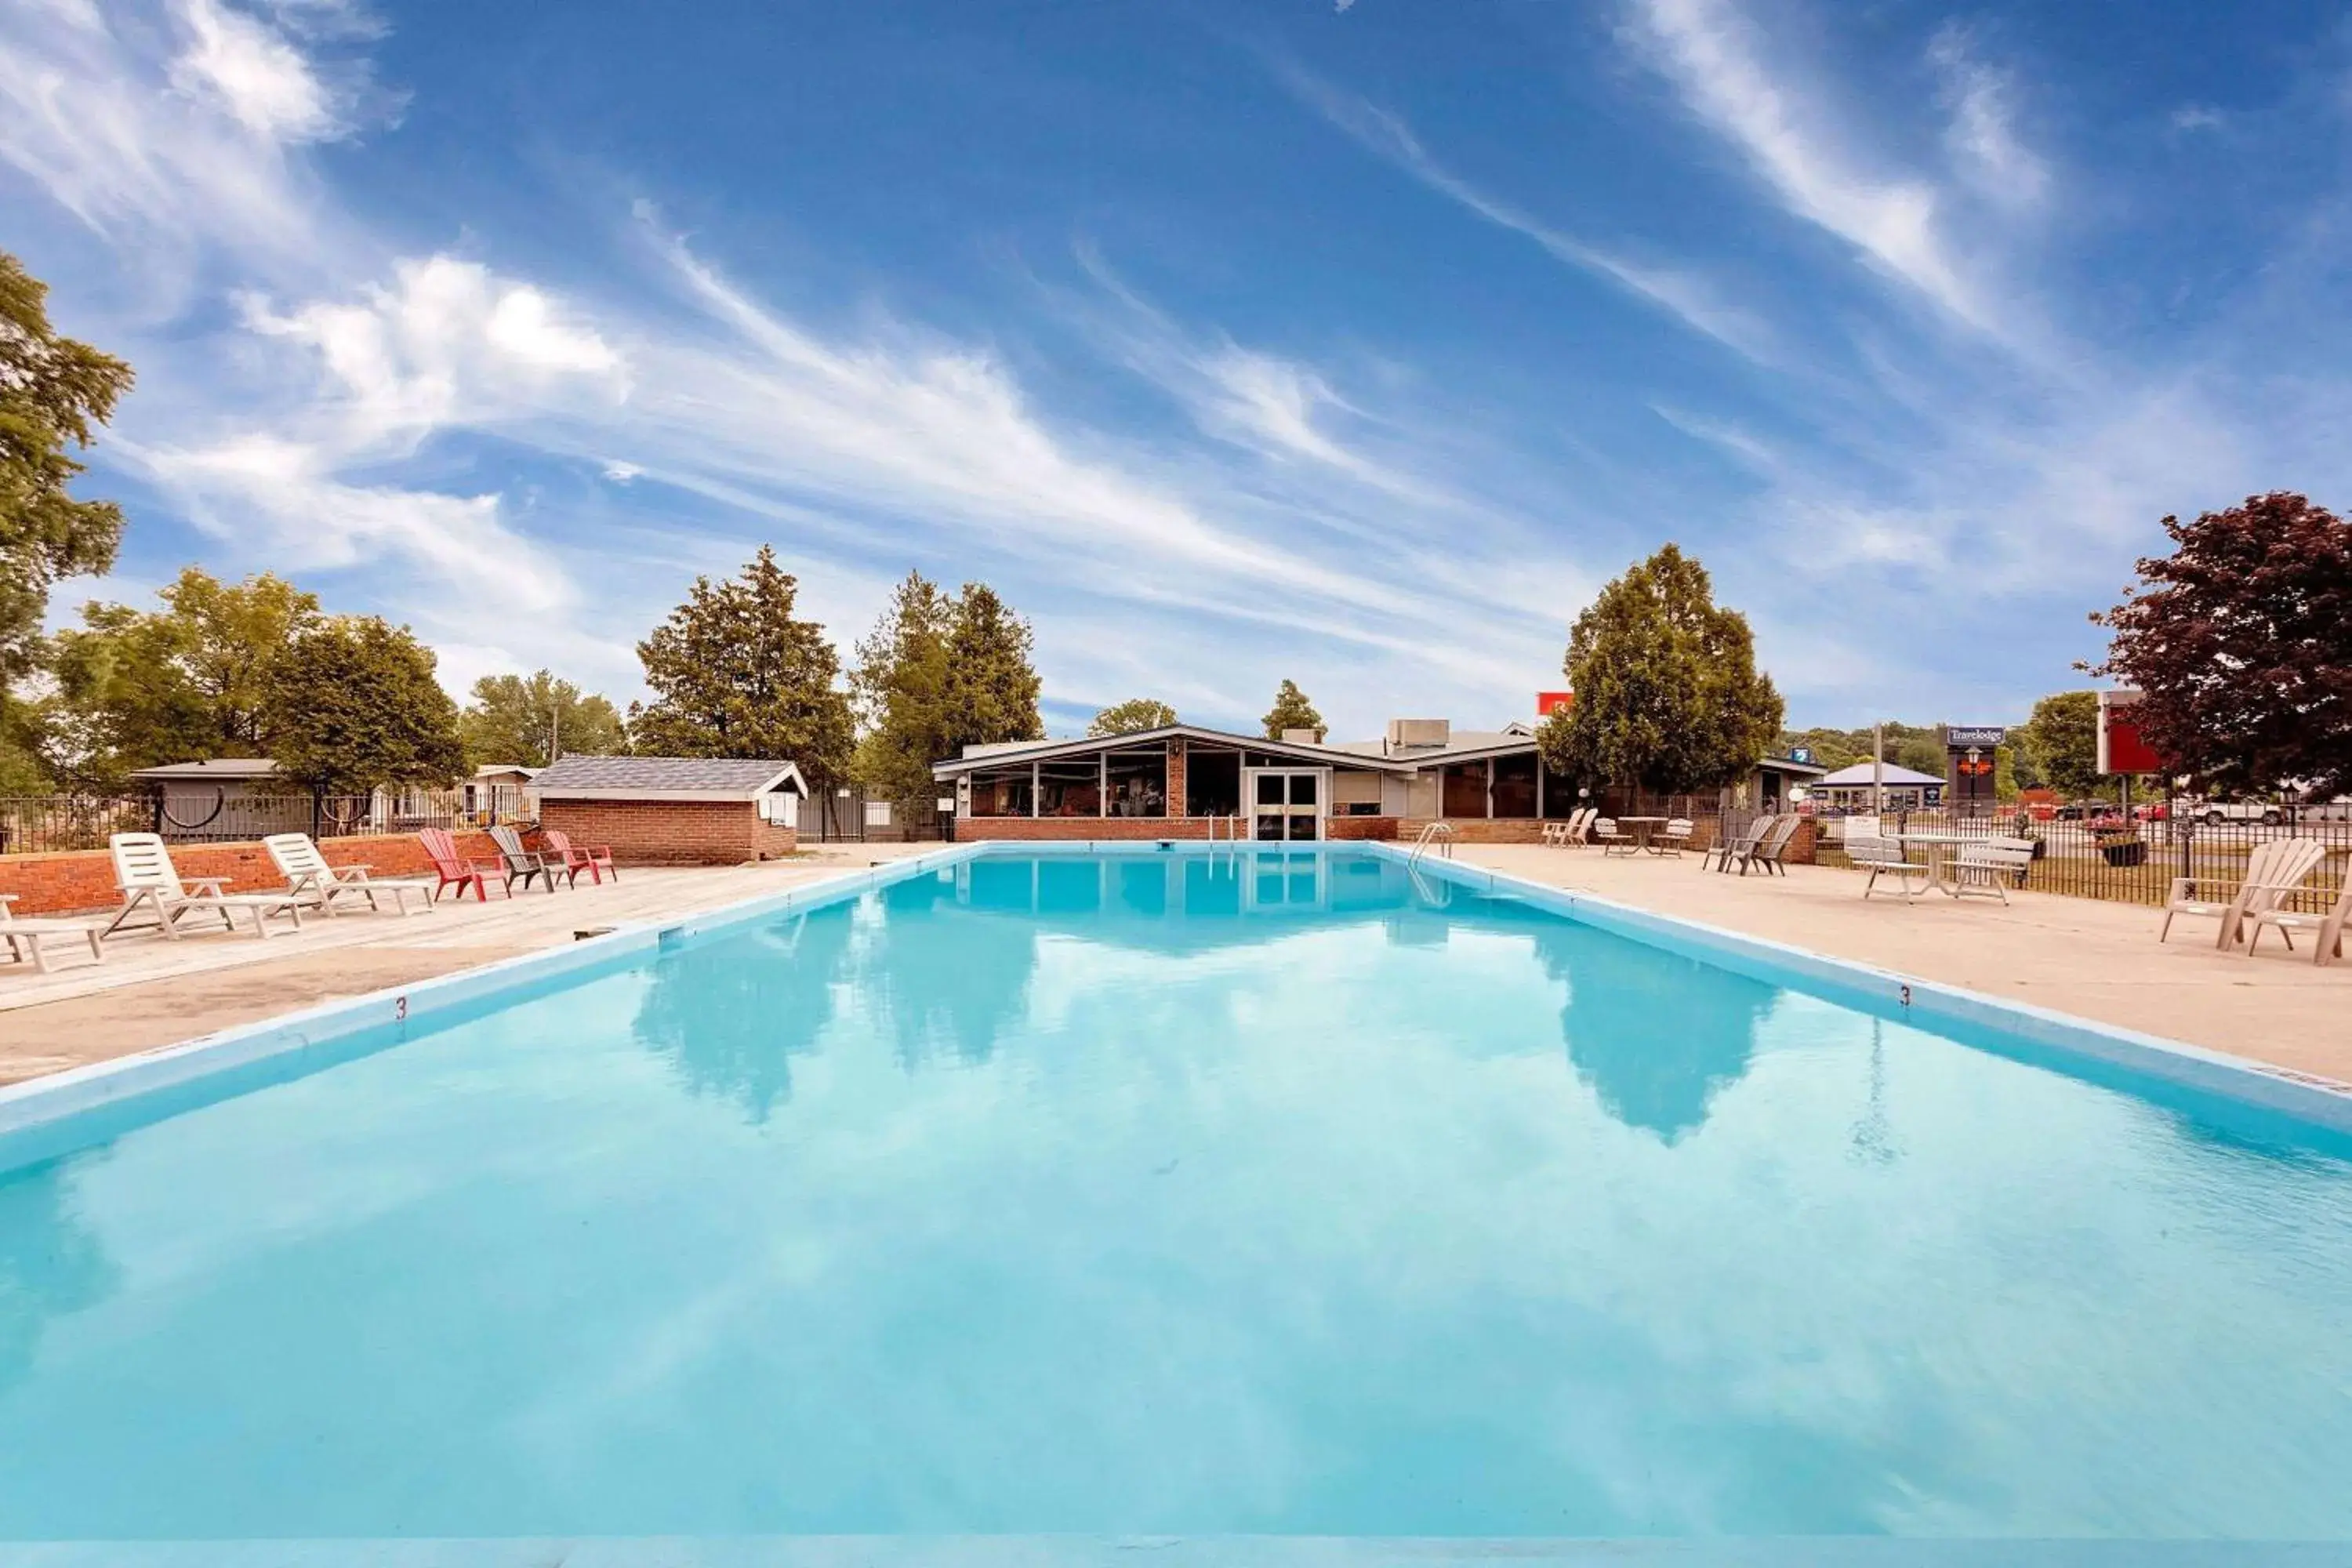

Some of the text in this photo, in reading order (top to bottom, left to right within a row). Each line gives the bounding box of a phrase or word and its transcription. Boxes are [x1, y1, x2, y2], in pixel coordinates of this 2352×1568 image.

[1951, 729, 2002, 742] Travelodge
[1900, 985, 1910, 1006] 3
[396, 996, 406, 1019] 3
